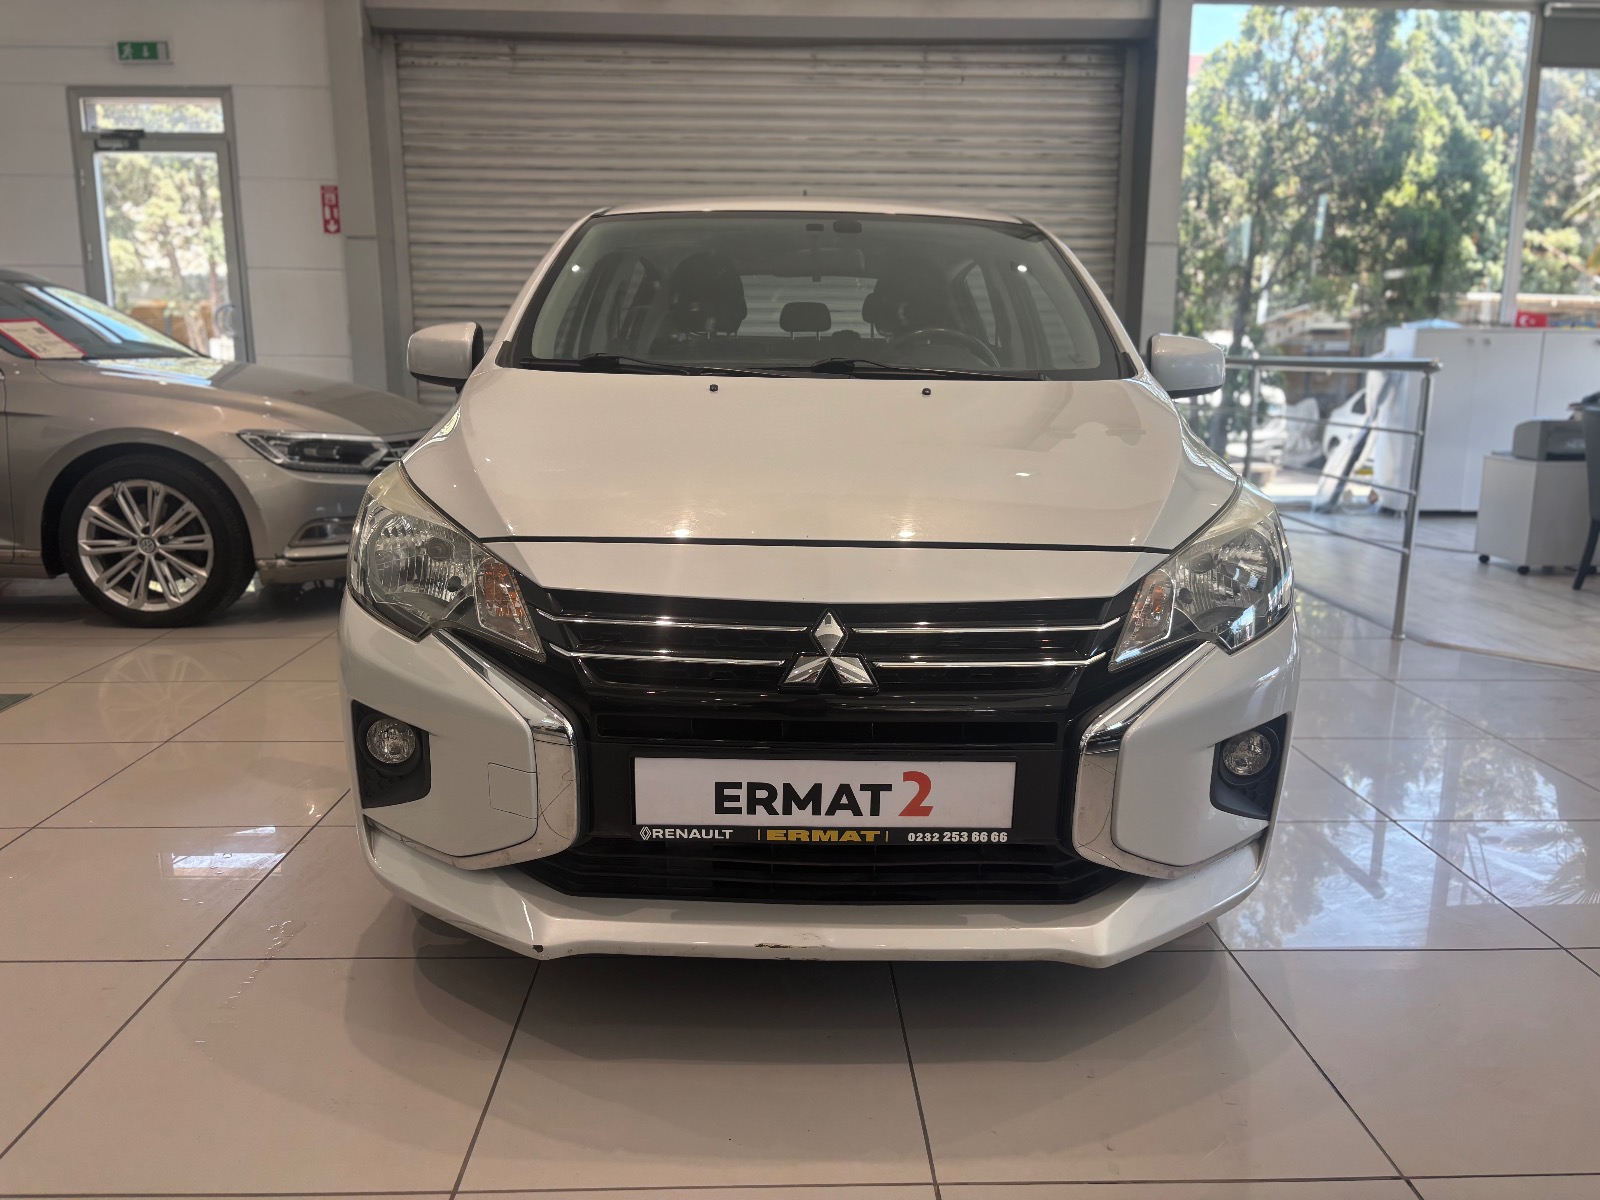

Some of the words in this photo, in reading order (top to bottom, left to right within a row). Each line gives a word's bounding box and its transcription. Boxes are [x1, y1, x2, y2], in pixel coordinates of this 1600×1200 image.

[715, 781, 893, 817] ERMAT
[898, 770, 934, 817] 2
[652, 828, 734, 840] RENAULT
[766, 829, 881, 843] ERMAT
[907, 832, 940, 842] 0232
[943, 831, 969, 843] 253
[971, 831, 988, 843] 66
[990, 831, 1008, 843] 66
